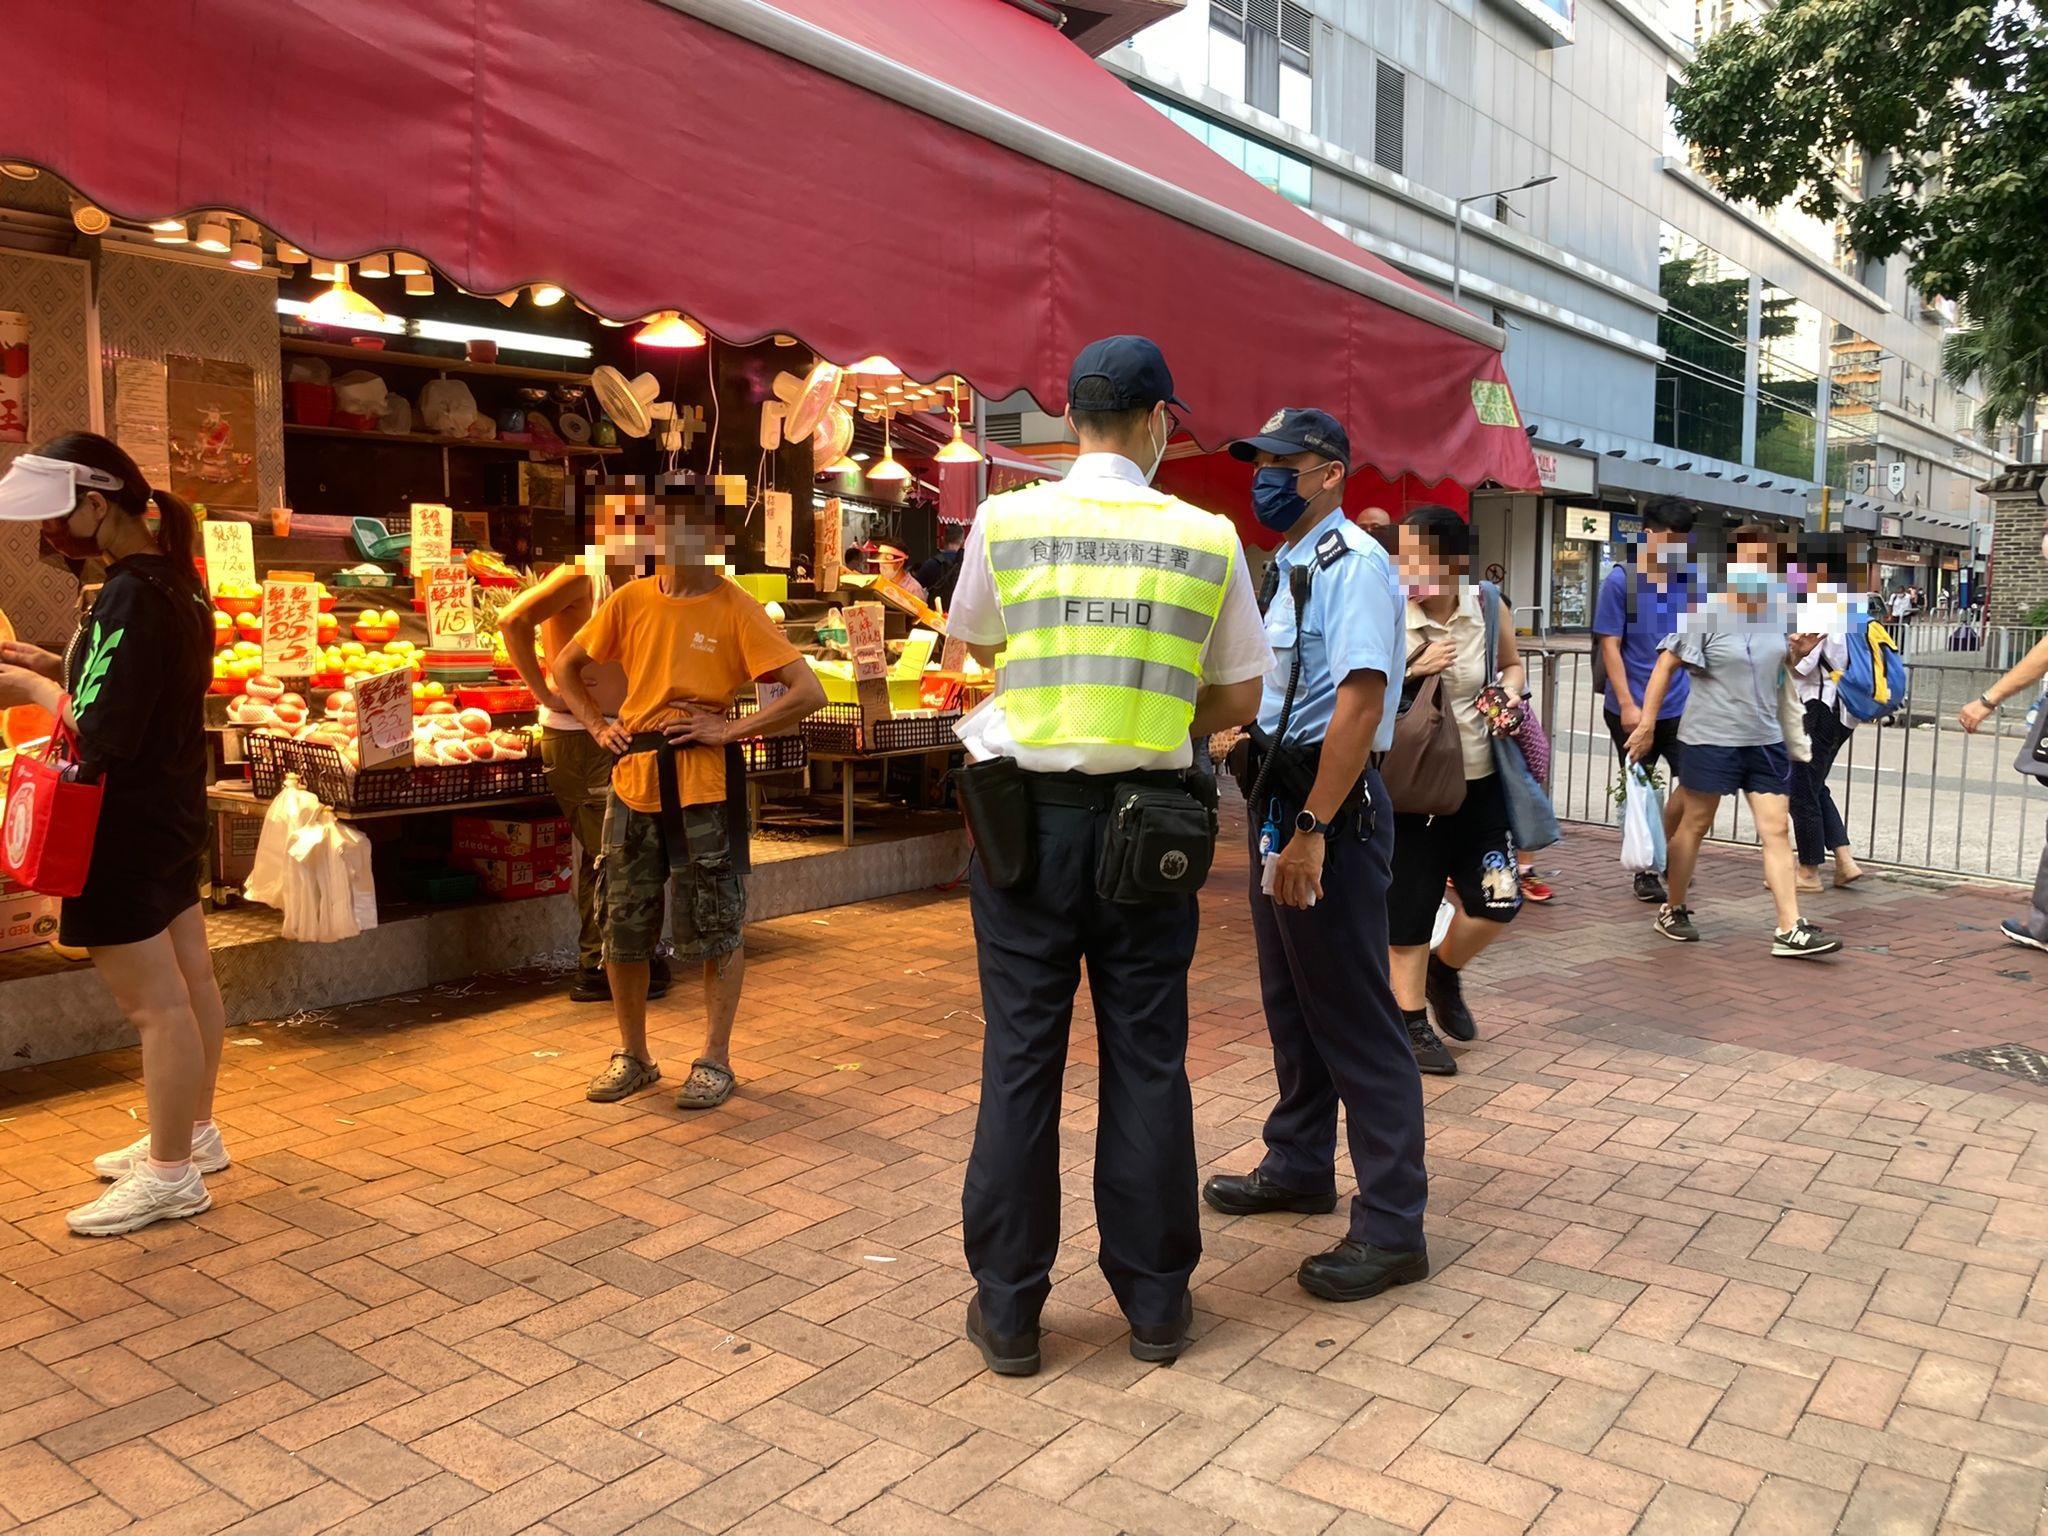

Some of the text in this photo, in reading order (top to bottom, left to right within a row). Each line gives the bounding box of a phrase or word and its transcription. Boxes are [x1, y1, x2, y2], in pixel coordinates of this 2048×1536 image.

[1893, 466, 1900, 474] P
[1065, 600, 1151, 625] FEHD
[458, 839, 498, 854] Papaya
[9, 924, 30, 937] RED
[1794, 932, 1811, 946] N
